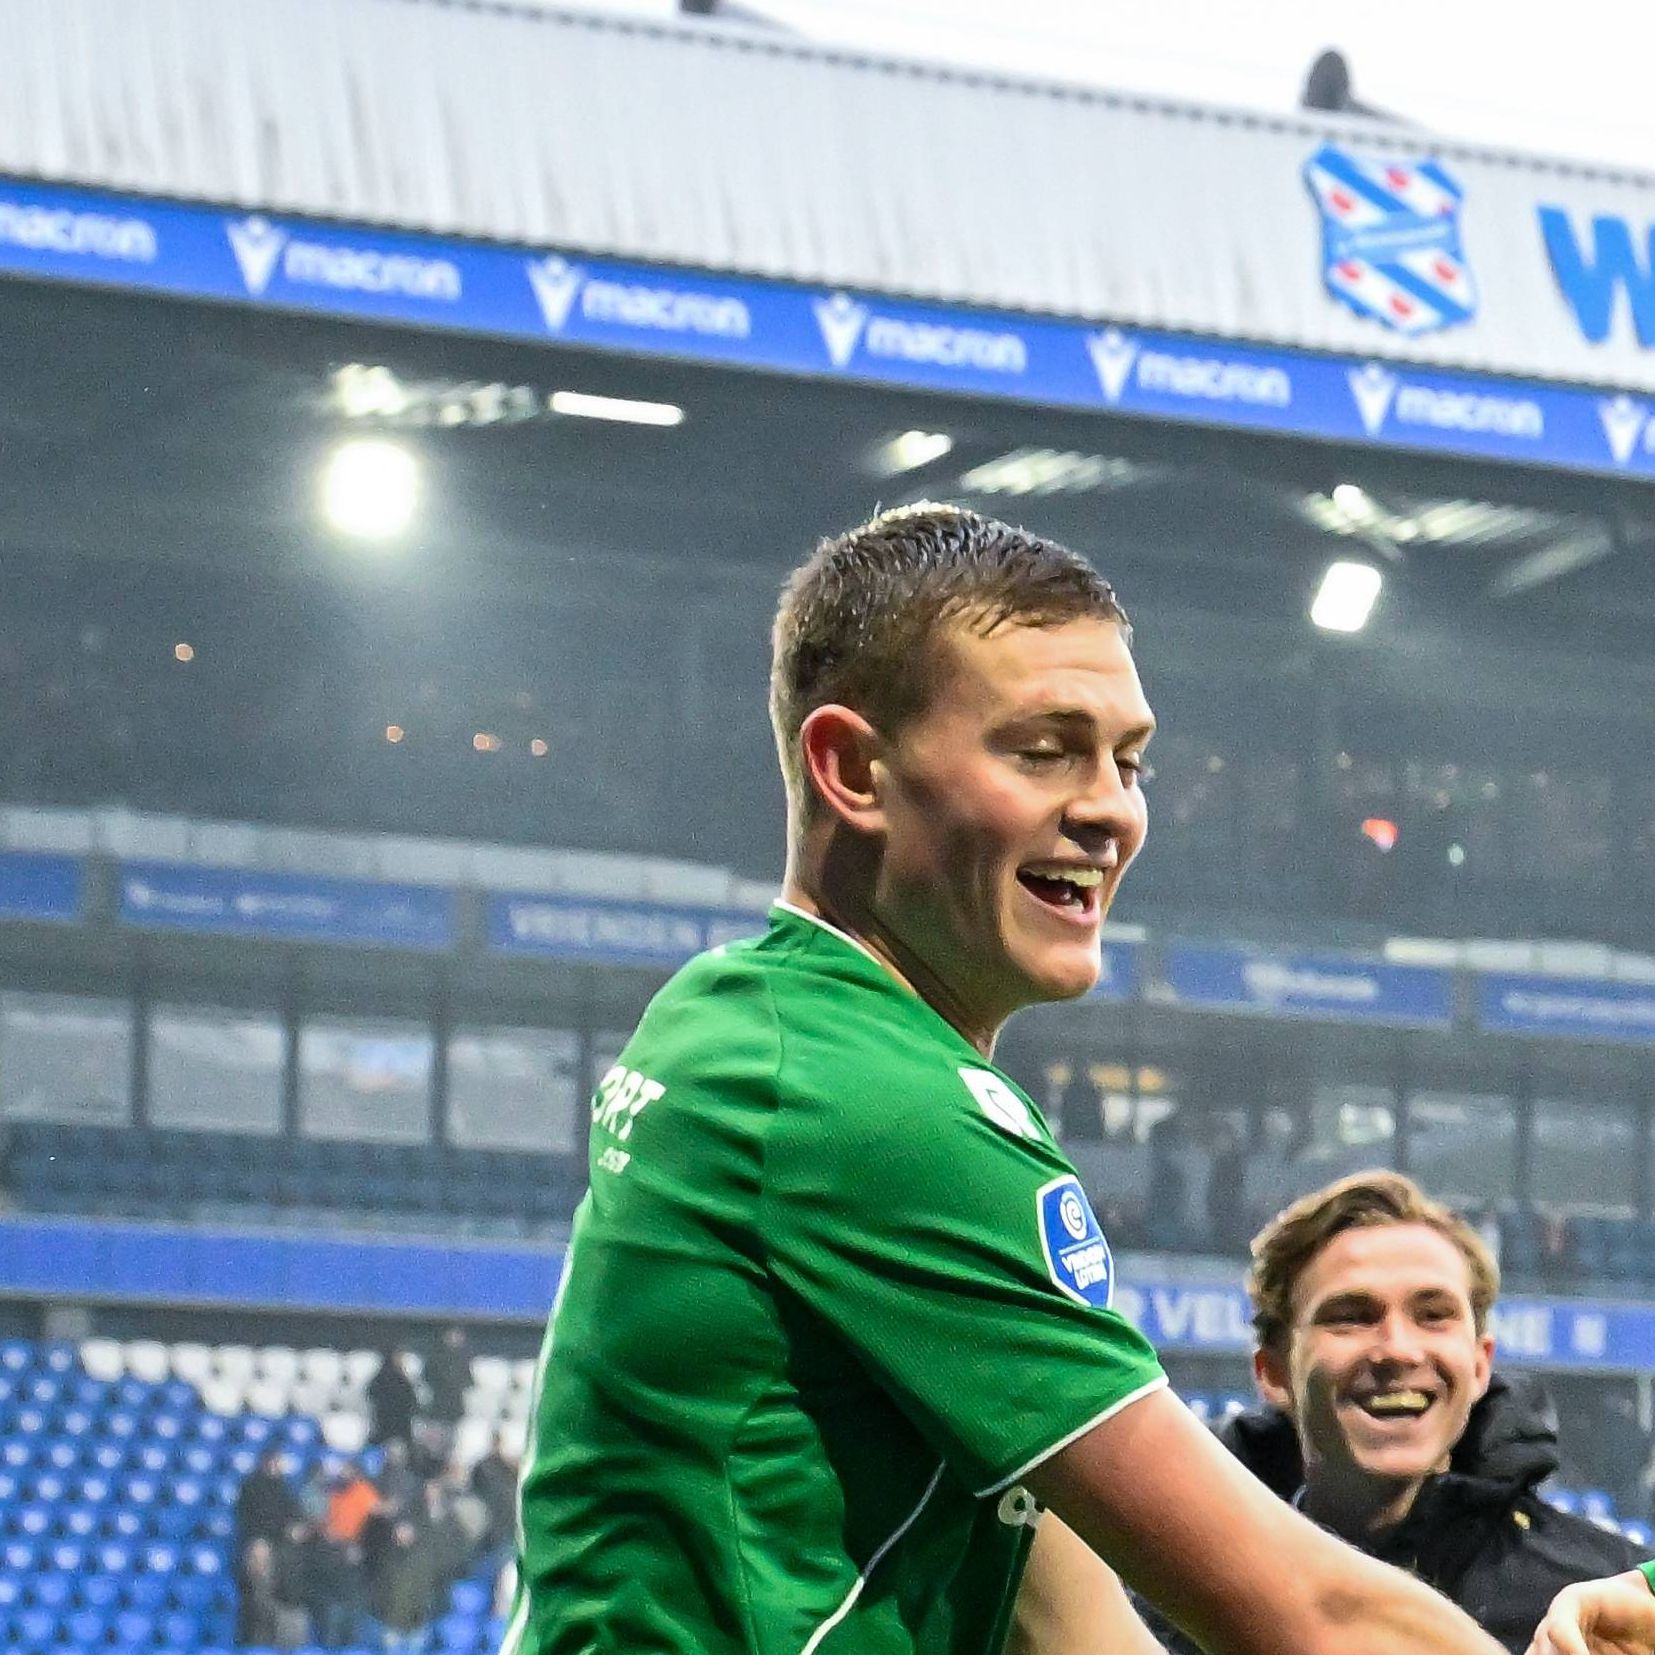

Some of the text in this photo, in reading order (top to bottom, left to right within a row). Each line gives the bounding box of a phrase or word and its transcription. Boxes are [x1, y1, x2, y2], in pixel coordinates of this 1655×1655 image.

[284, 241, 462, 301] macron
[580, 279, 751, 338] macron
[866, 317, 1027, 373] macron
[1137, 351, 1292, 407] macron
[1396, 384, 1544, 438] macron
